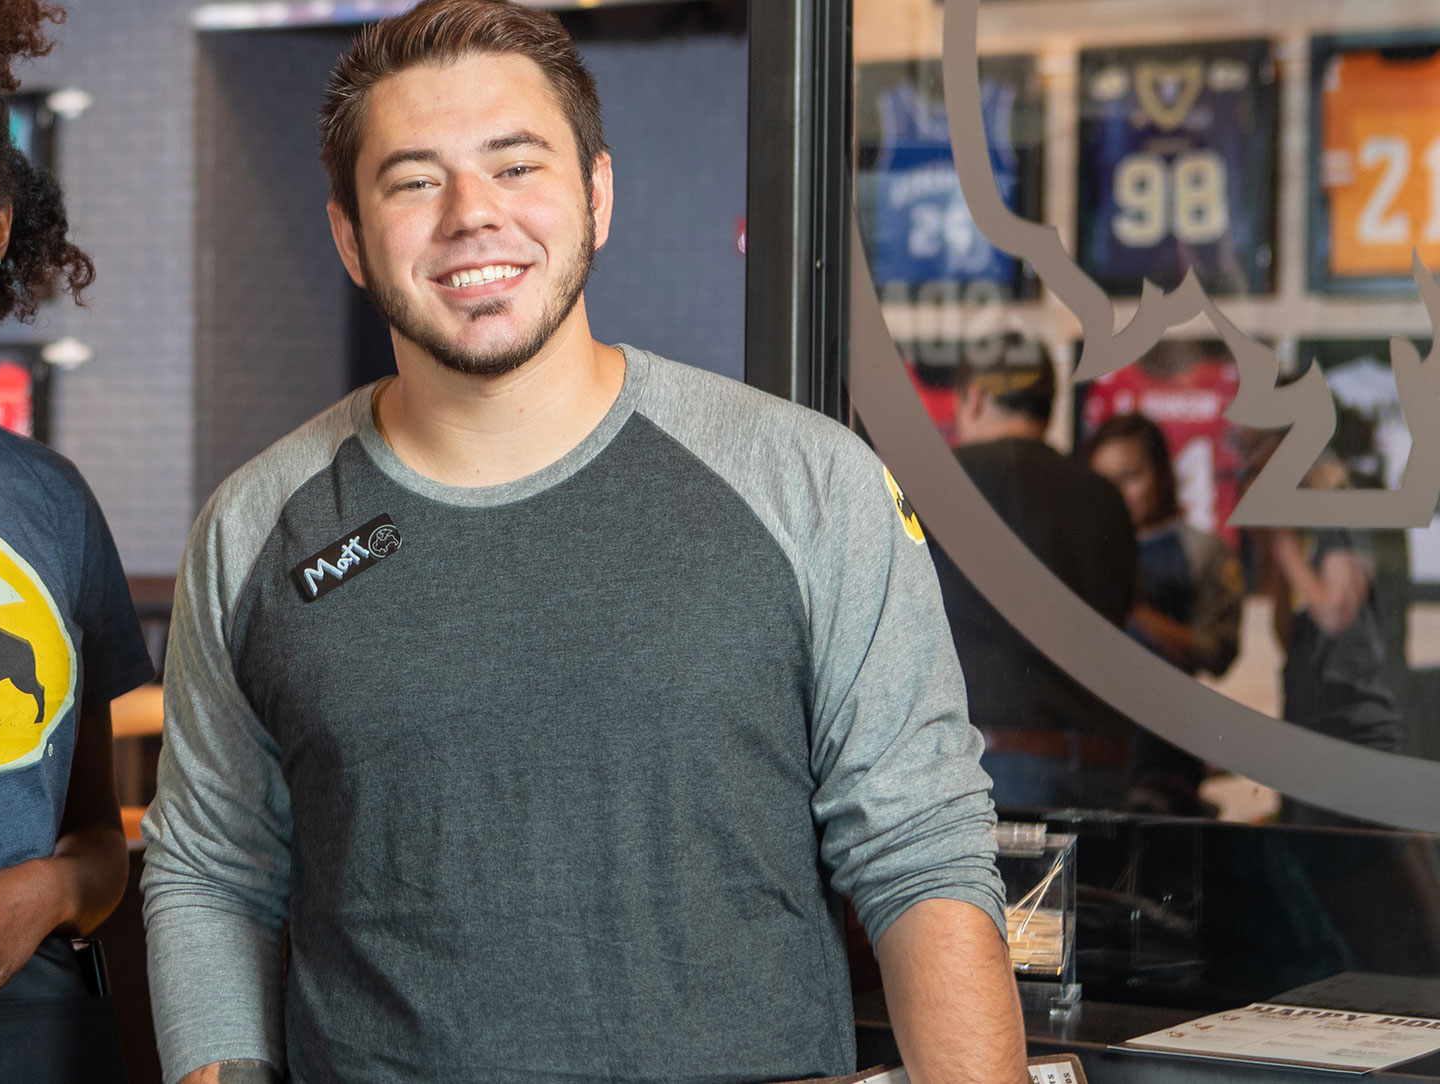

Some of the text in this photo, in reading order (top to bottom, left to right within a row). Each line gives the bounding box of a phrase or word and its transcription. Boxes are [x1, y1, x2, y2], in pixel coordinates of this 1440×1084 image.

[1112, 152, 1229, 246] 98
[303, 535, 370, 596] Matt
[1244, 1005, 1370, 1022] HAPPY
